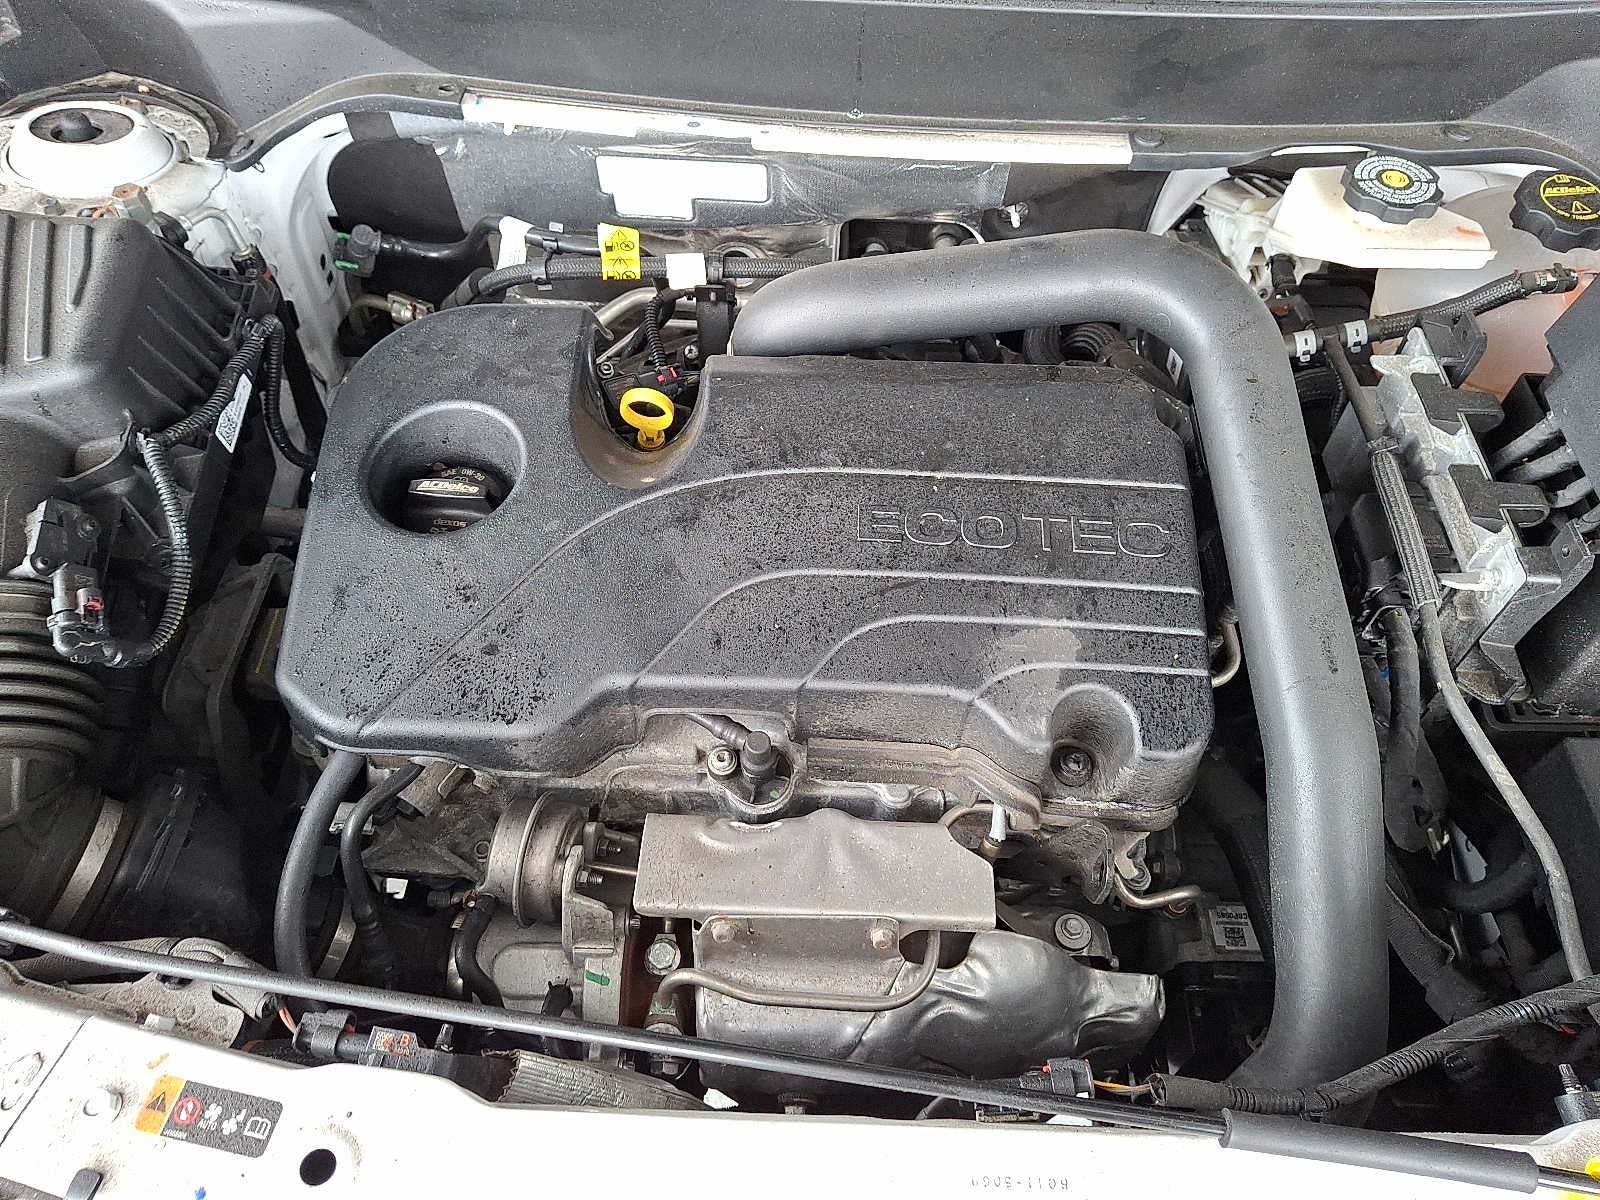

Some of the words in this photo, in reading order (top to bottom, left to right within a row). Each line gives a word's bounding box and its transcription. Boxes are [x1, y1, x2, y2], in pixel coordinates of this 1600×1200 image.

[1544, 186, 1596, 197] ACDelco
[441, 468, 457, 477] SAE
[461, 469, 485, 481] 0W-20
[416, 480, 480, 493] ACDelco
[433, 518, 467, 528] dexos
[857, 505, 1171, 558] ECOTEC
[197, 1118, 217, 1131] AUTO
